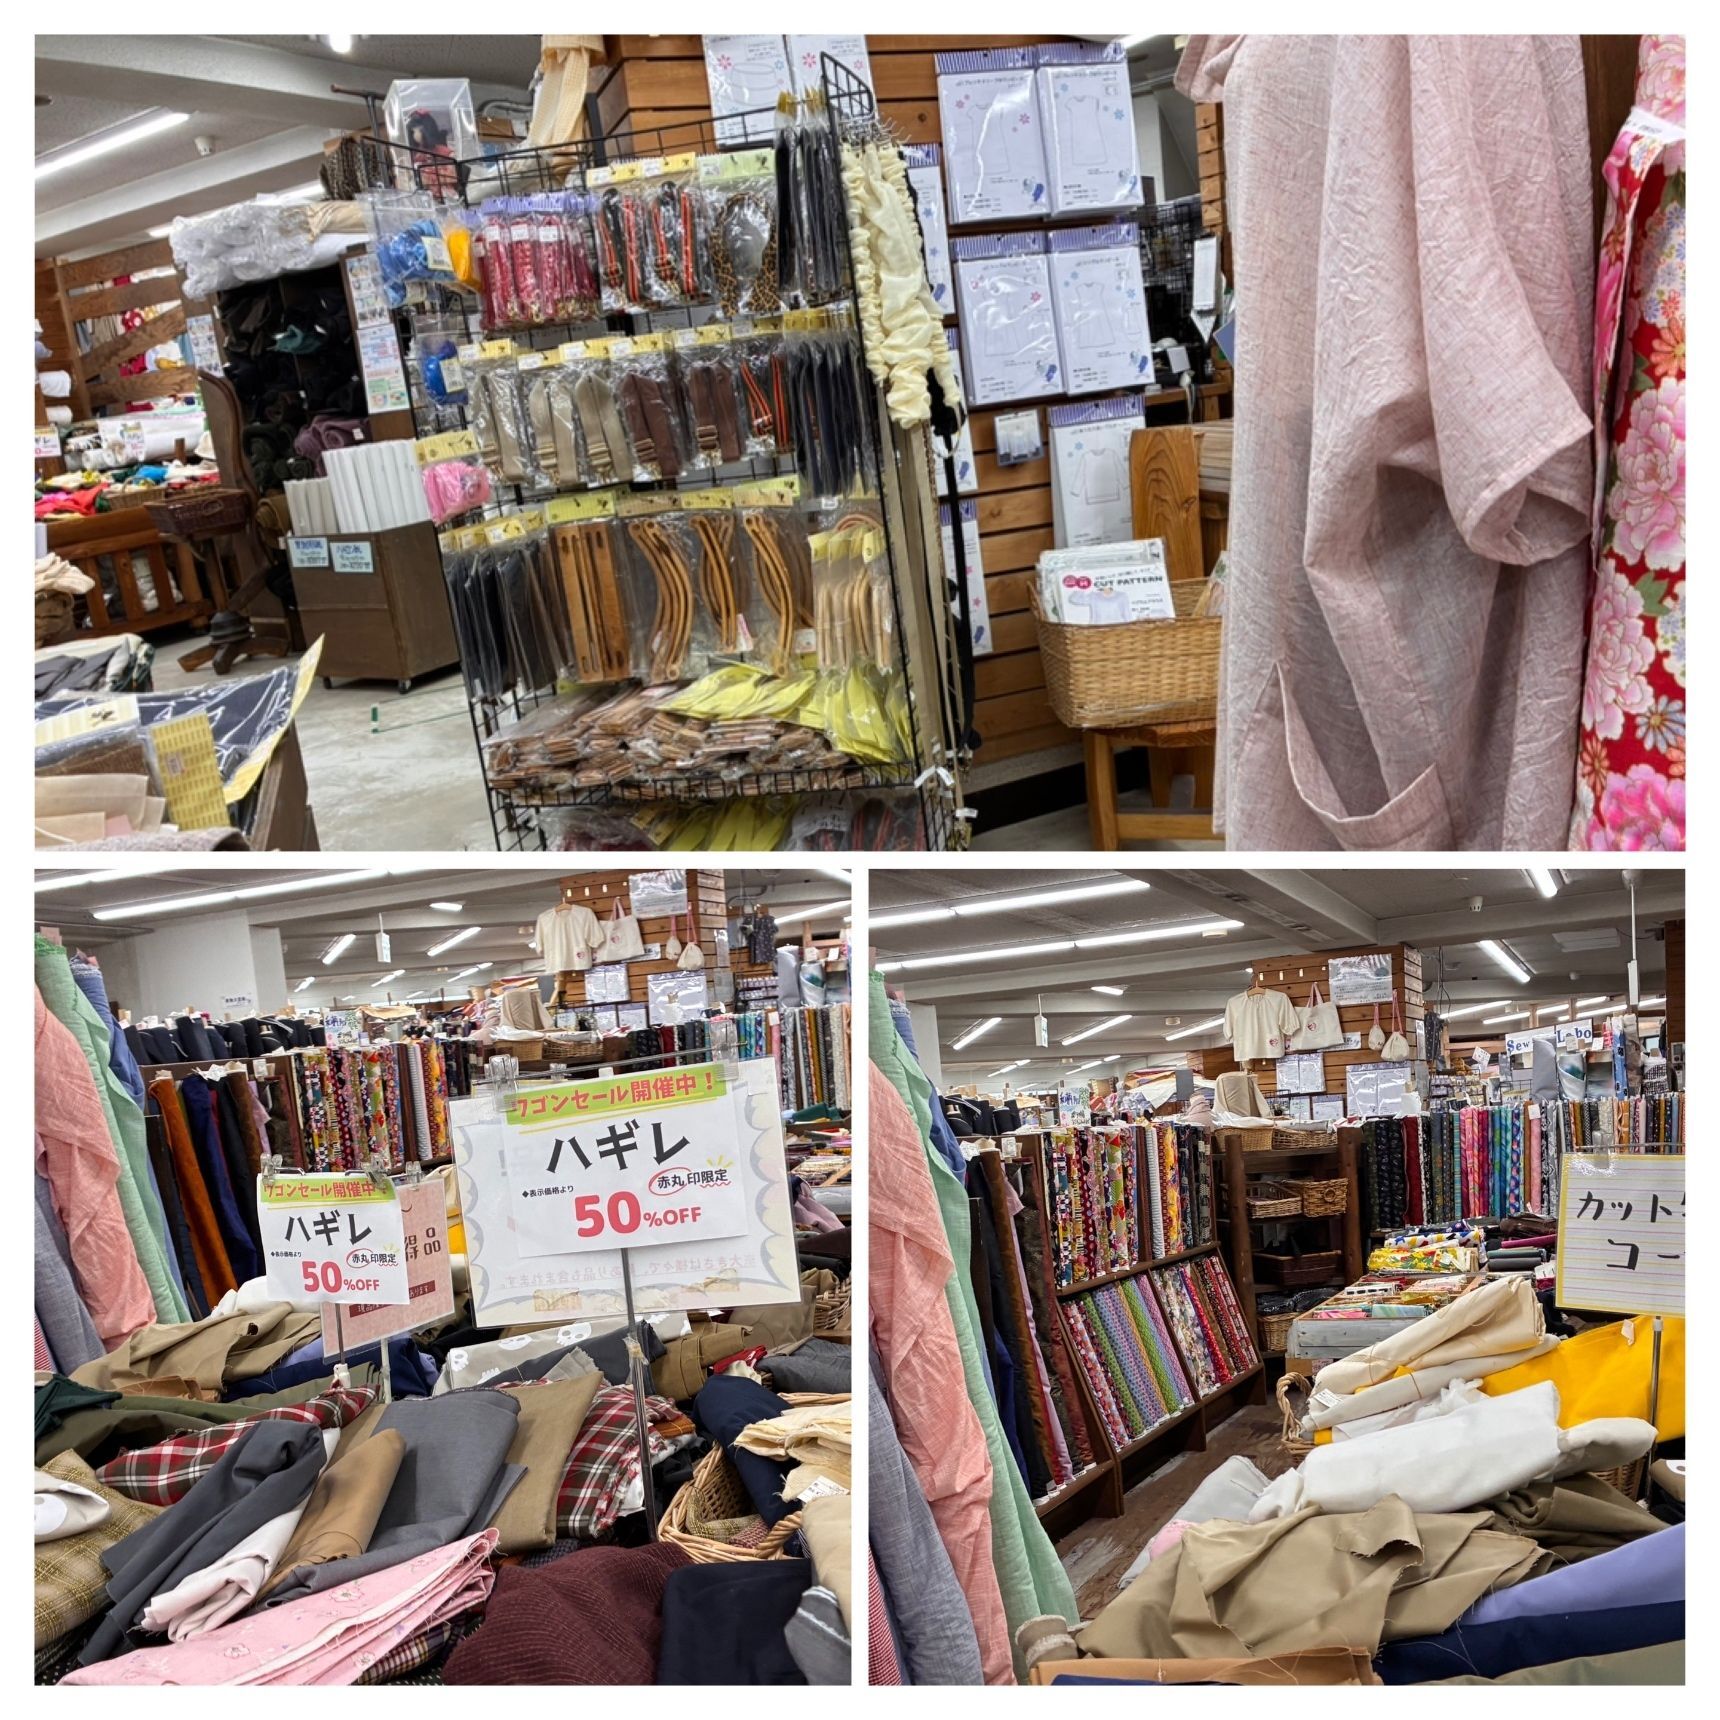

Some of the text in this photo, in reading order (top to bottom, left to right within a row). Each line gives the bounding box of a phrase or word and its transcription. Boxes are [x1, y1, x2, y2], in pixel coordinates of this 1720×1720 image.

[1117, 576, 1163, 586] PATTERN
[1506, 1038, 1530, 1053] Sew
[546, 1119, 691, 1174] ハギレ
[657, 1168, 729, 1190] 赤丸印限定
[1577, 1191, 1685, 1223] カット
[285, 1210, 373, 1246] ハギレ
[352, 1253, 397, 1264] 赤丸印限定
